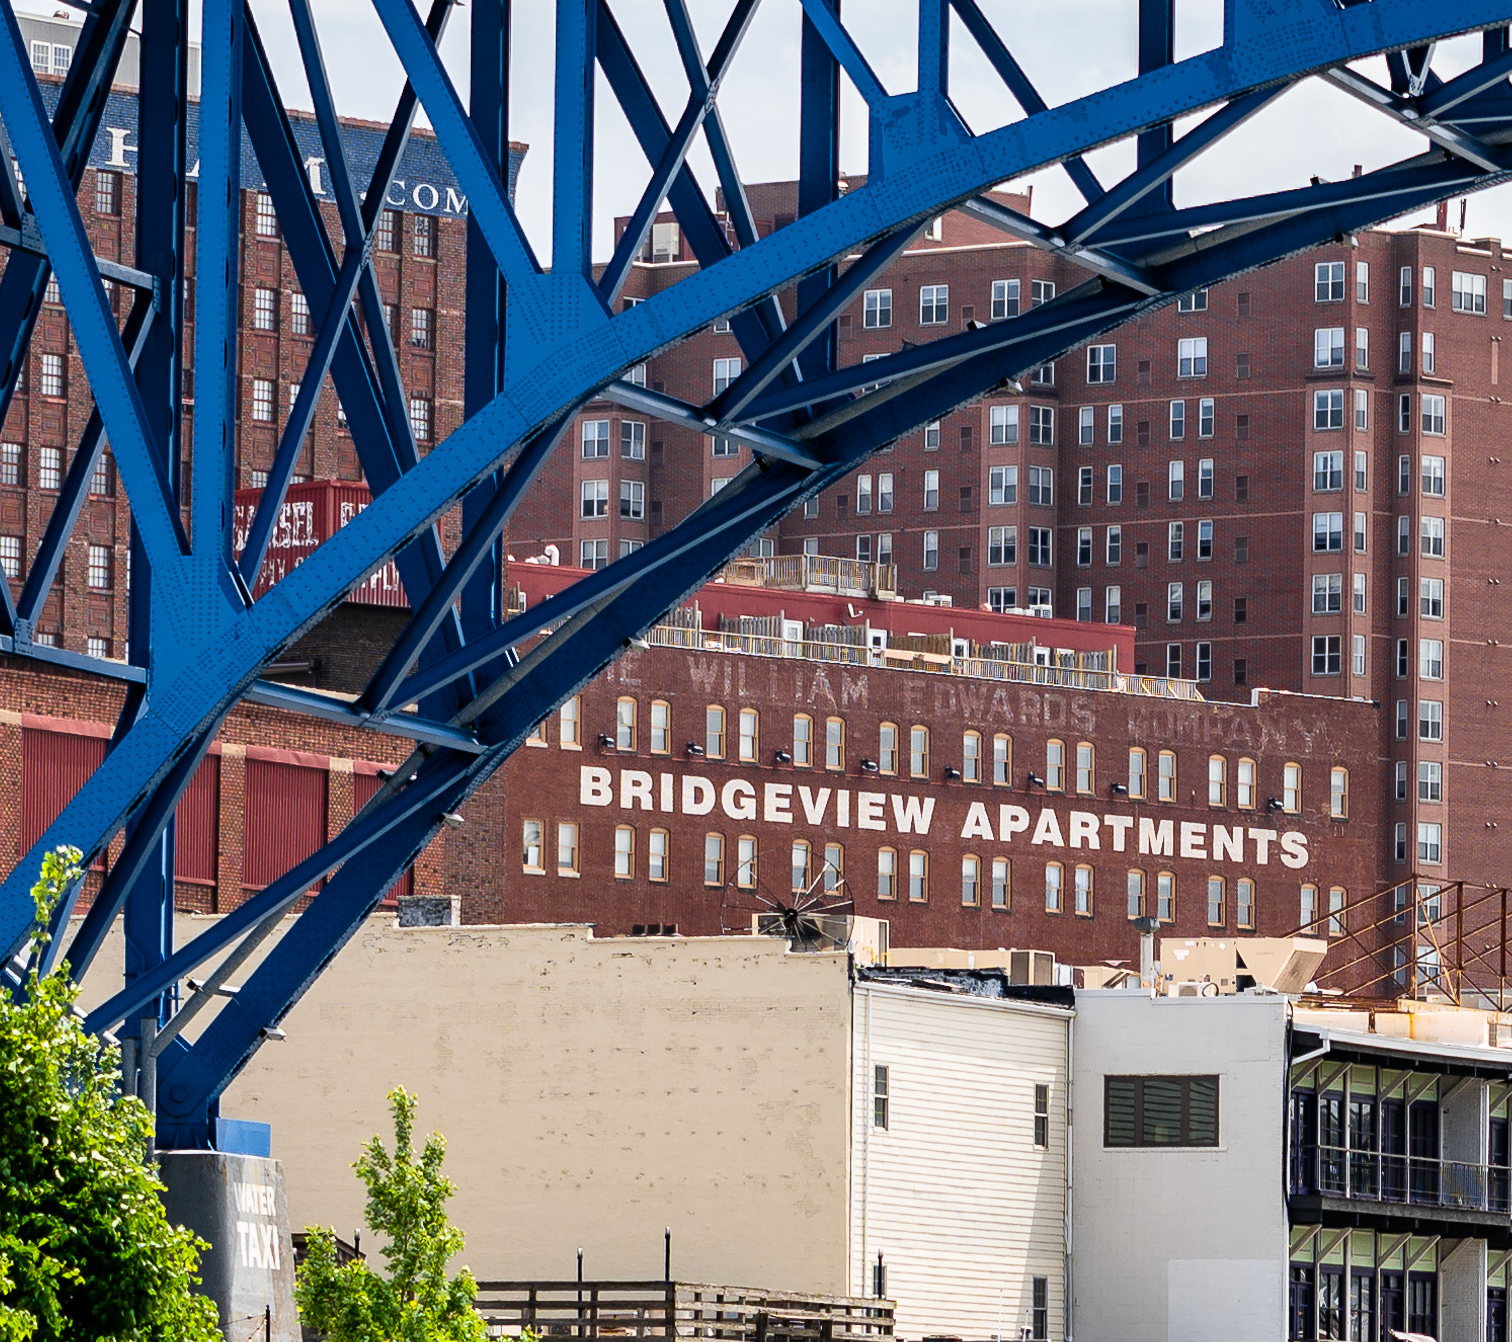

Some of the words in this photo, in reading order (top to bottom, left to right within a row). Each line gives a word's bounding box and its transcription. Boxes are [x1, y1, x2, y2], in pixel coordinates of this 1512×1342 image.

[579, 765, 937, 835] BRIDGEVIEW
[960, 801, 1310, 870] APARTMENTS
[233, 1181, 277, 1217] WATER
[236, 1220, 281, 1271] TAXI
